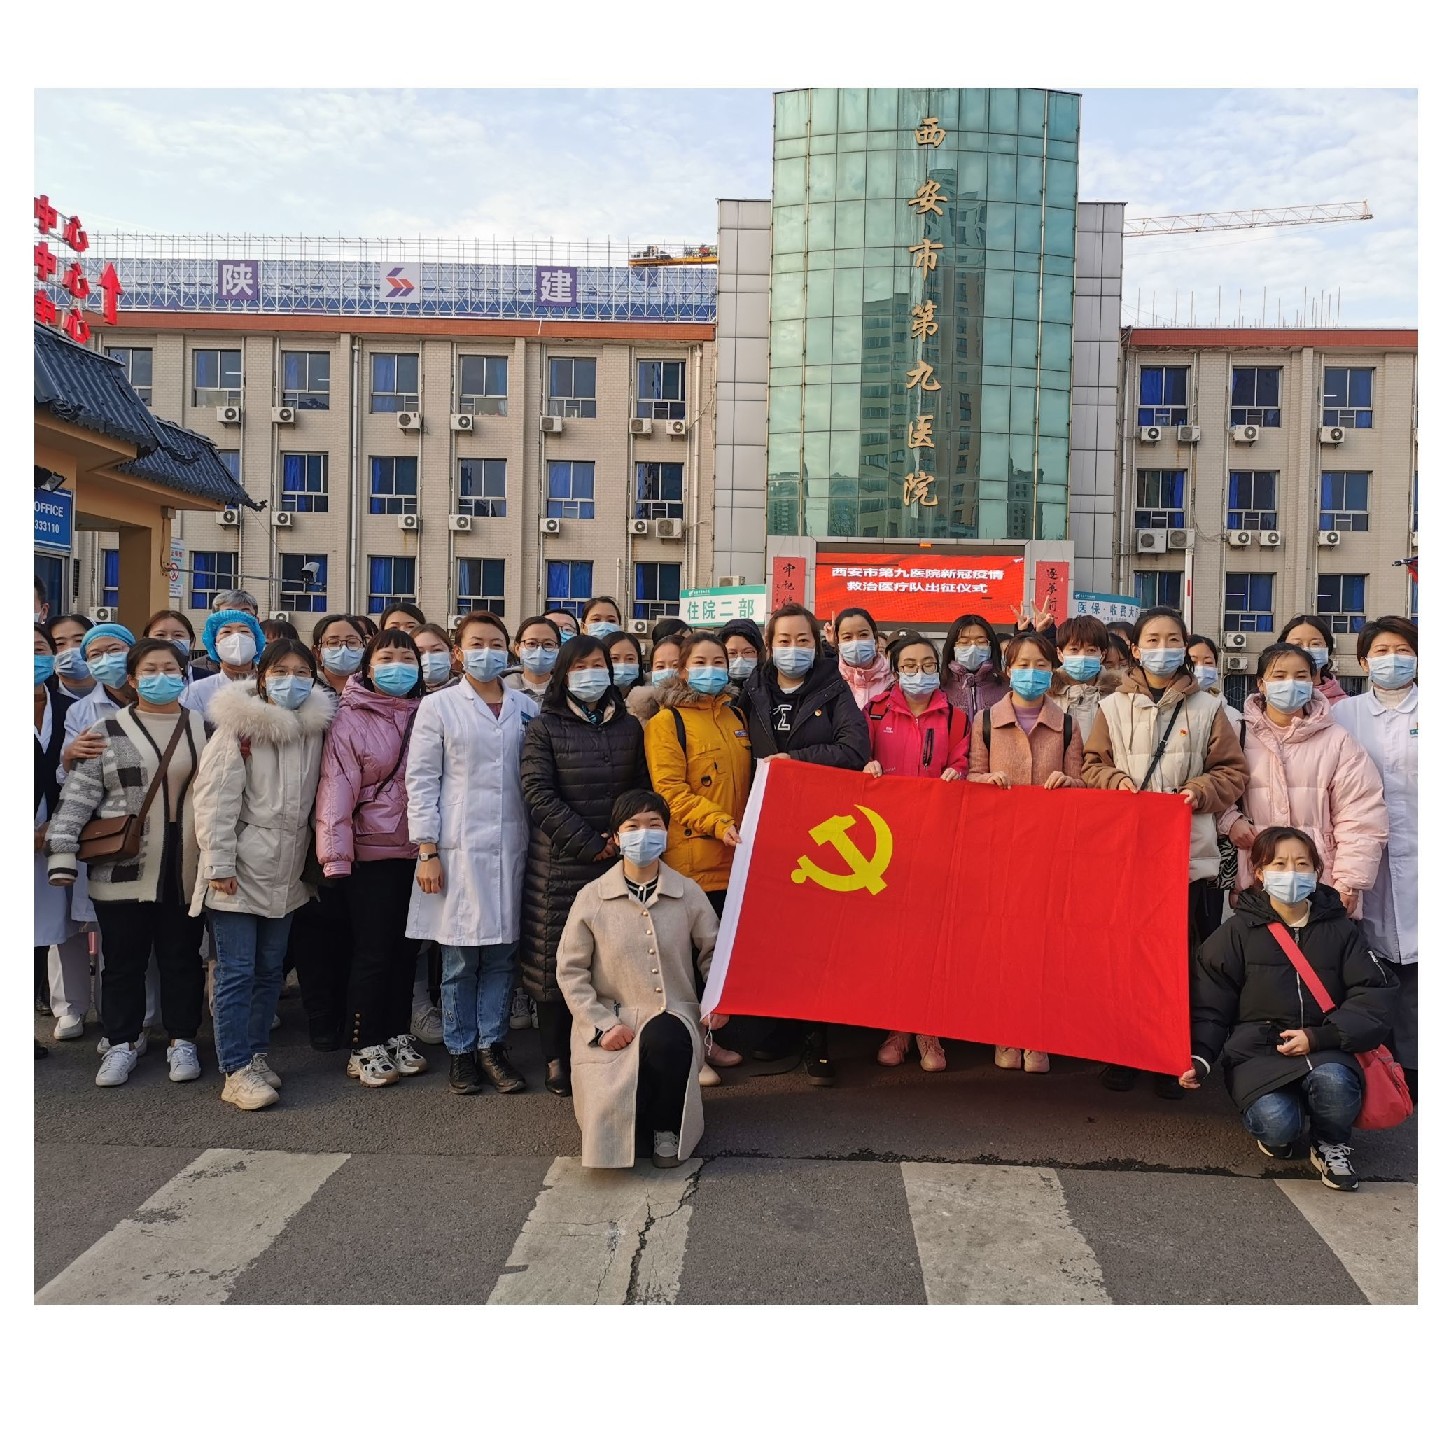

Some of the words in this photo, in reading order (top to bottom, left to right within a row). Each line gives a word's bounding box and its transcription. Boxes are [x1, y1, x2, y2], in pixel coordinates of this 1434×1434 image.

[221, 264, 253, 297] 陕
[540, 269, 573, 303] 建
[903, 117, 947, 507] 西安市第九医院
[34, 501, 64, 518] OFFICE
[831, 567, 1005, 580] 西安市第九医院新冠疫情
[846, 581, 988, 593] 救治医疗队出征仪式
[687, 598, 755, 620] 住院二部
